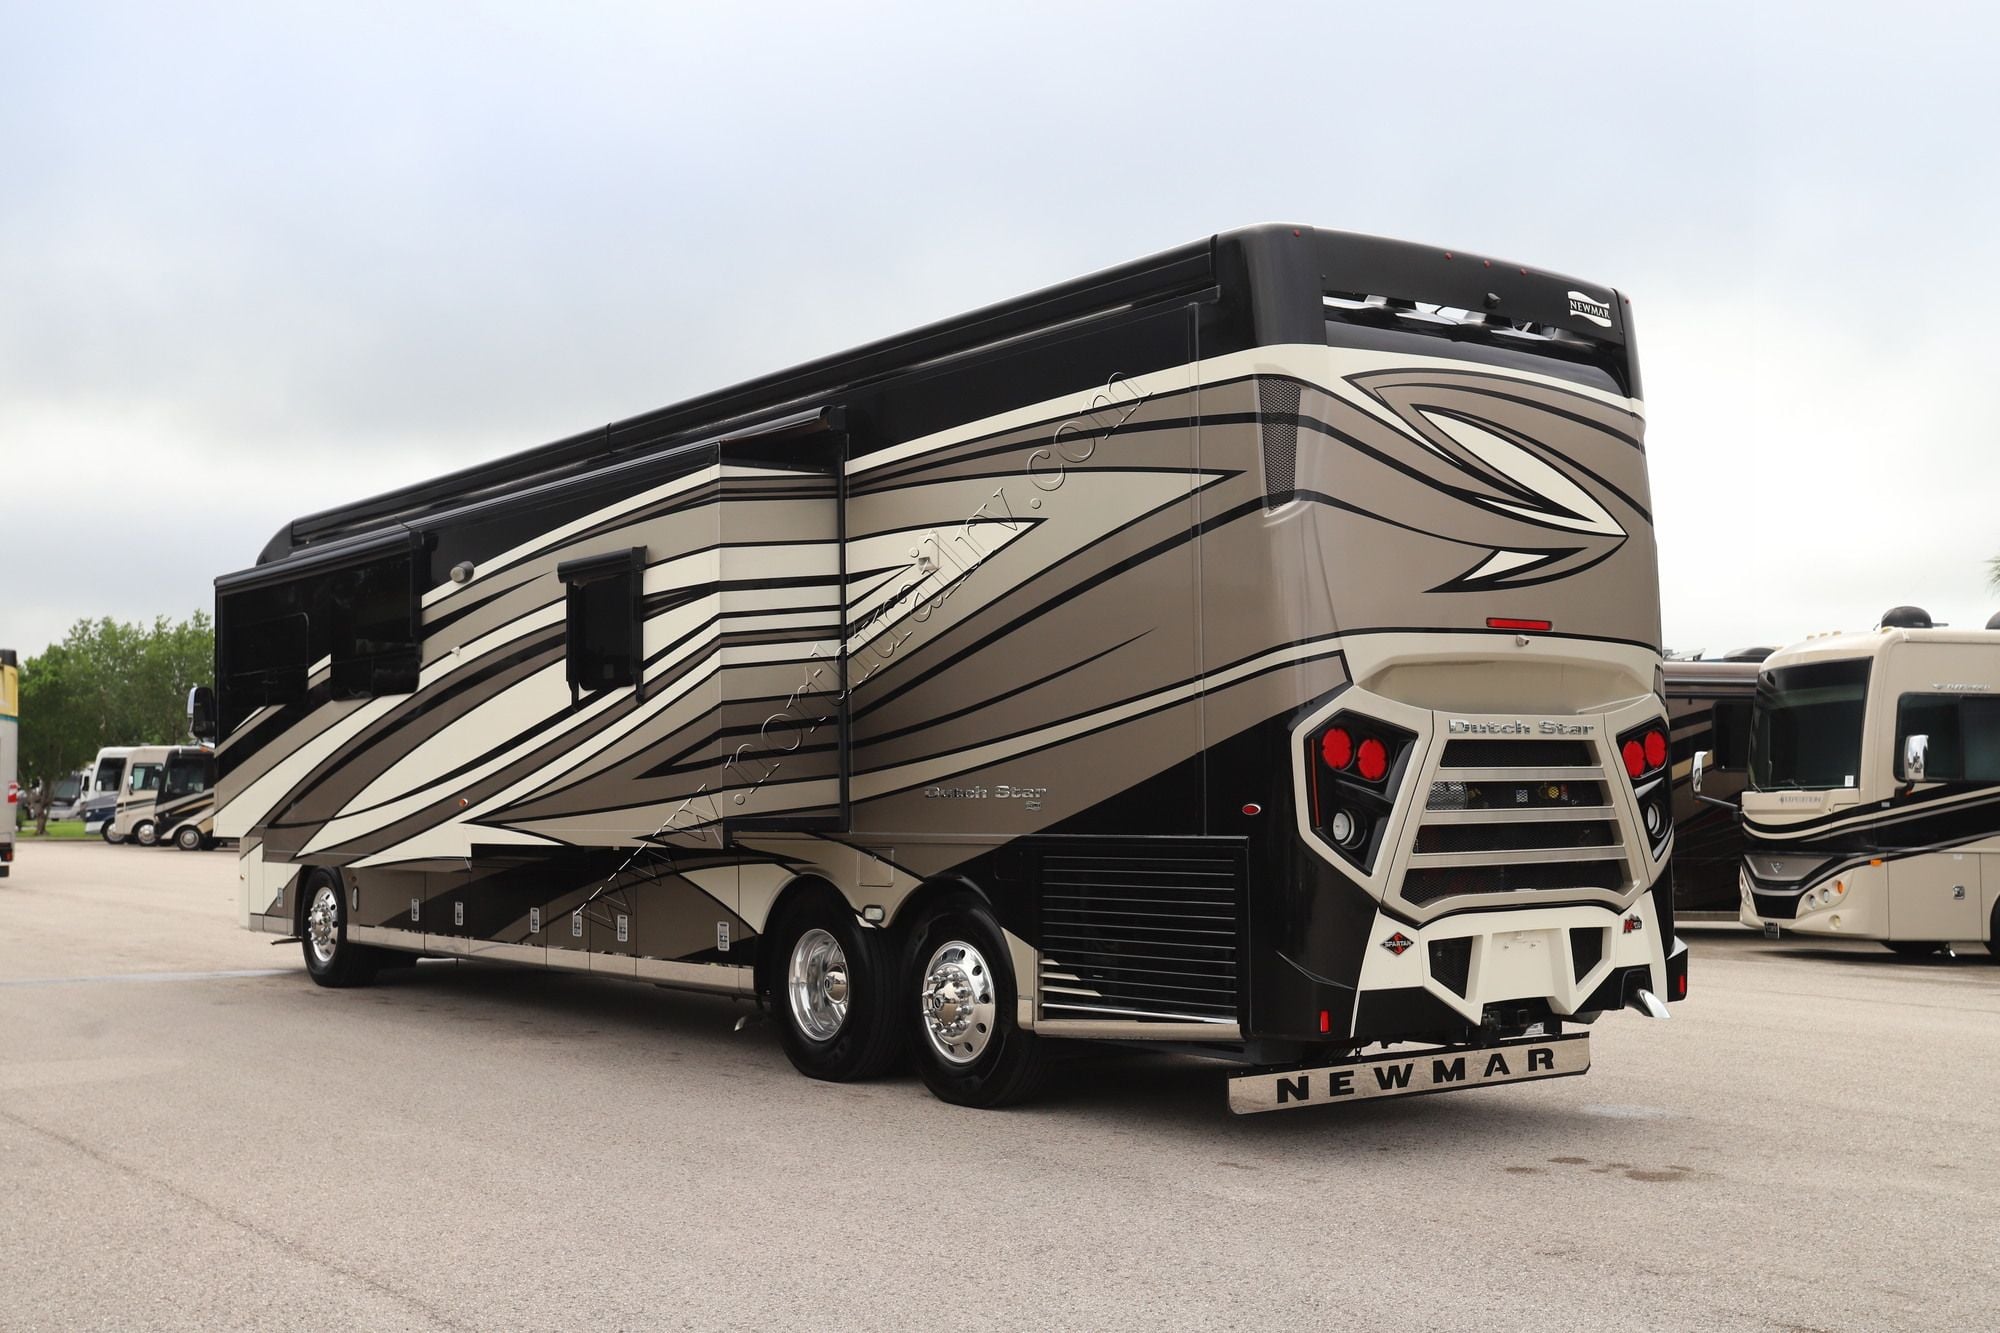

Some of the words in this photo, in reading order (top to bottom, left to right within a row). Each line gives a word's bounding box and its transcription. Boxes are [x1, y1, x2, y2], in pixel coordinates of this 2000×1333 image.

[1569, 300, 1610, 319] NEWMAR
[1448, 719, 1531, 735] Dutch
[1538, 720, 1594, 735] Star
[924, 785, 988, 799] Dutch
[994, 785, 1047, 799] Star
[1276, 1047, 1555, 1104] NEWMAR
